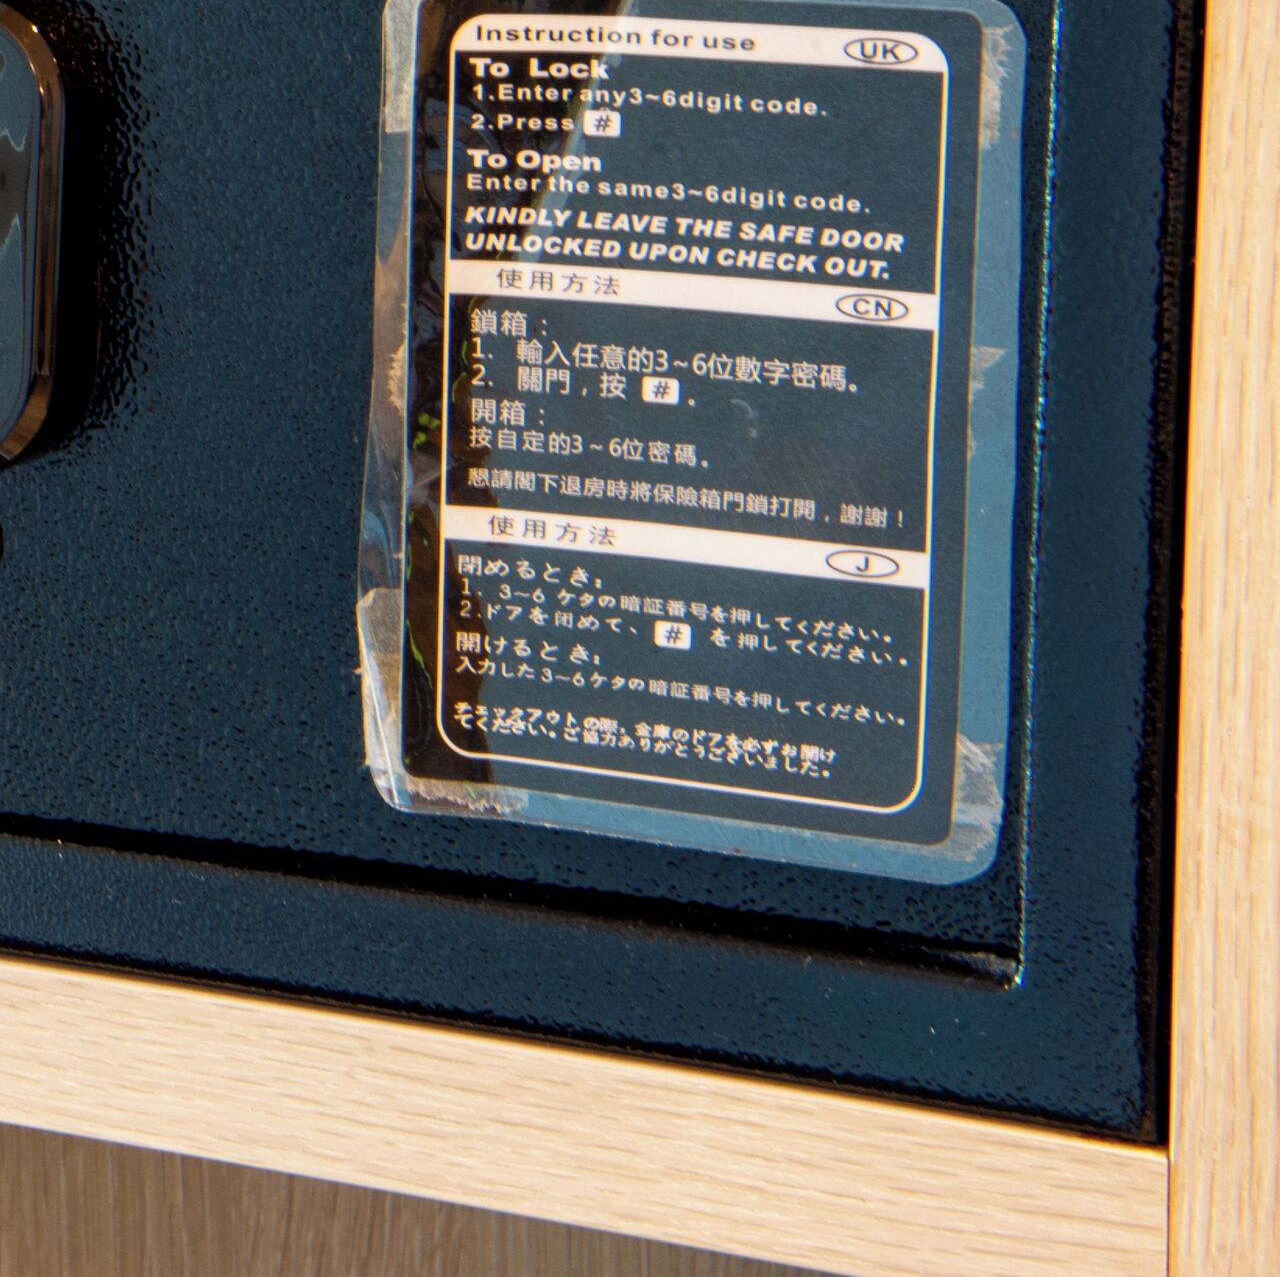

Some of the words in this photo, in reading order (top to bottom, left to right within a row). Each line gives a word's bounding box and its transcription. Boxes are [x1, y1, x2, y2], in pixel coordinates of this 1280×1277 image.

[476, 25, 641, 45] Instruction
[652, 30, 693, 49] for
[703, 35, 756, 51] use
[859, 41, 901, 61] UK
[469, 57, 510, 78] To
[529, 58, 610, 79] Lock
[750, 97, 828, 117] code.
[467, 148, 508, 169] To
[516, 150, 602, 173] Open
[466, 173, 542, 192] Enter
[549, 175, 590, 193] the
[794, 194, 871, 214] code.
[465, 206, 572, 228] KINDLY
[577, 211, 669, 234] LEAVE
[676, 217, 733, 239] THE
[739, 222, 815, 245] SAFE
[820, 228, 905, 253] DOOR
[465, 232, 622, 259] UNLOCKED
[628, 241, 710, 265] UPON
[716, 248, 819, 274] CHECK
[824, 257, 891, 280] OUT.
[496, 268, 622, 297] 使用方法
[852, 297, 892, 318] CN
[488, 514, 617, 547] 使用方法
[855, 555, 870, 572] J
